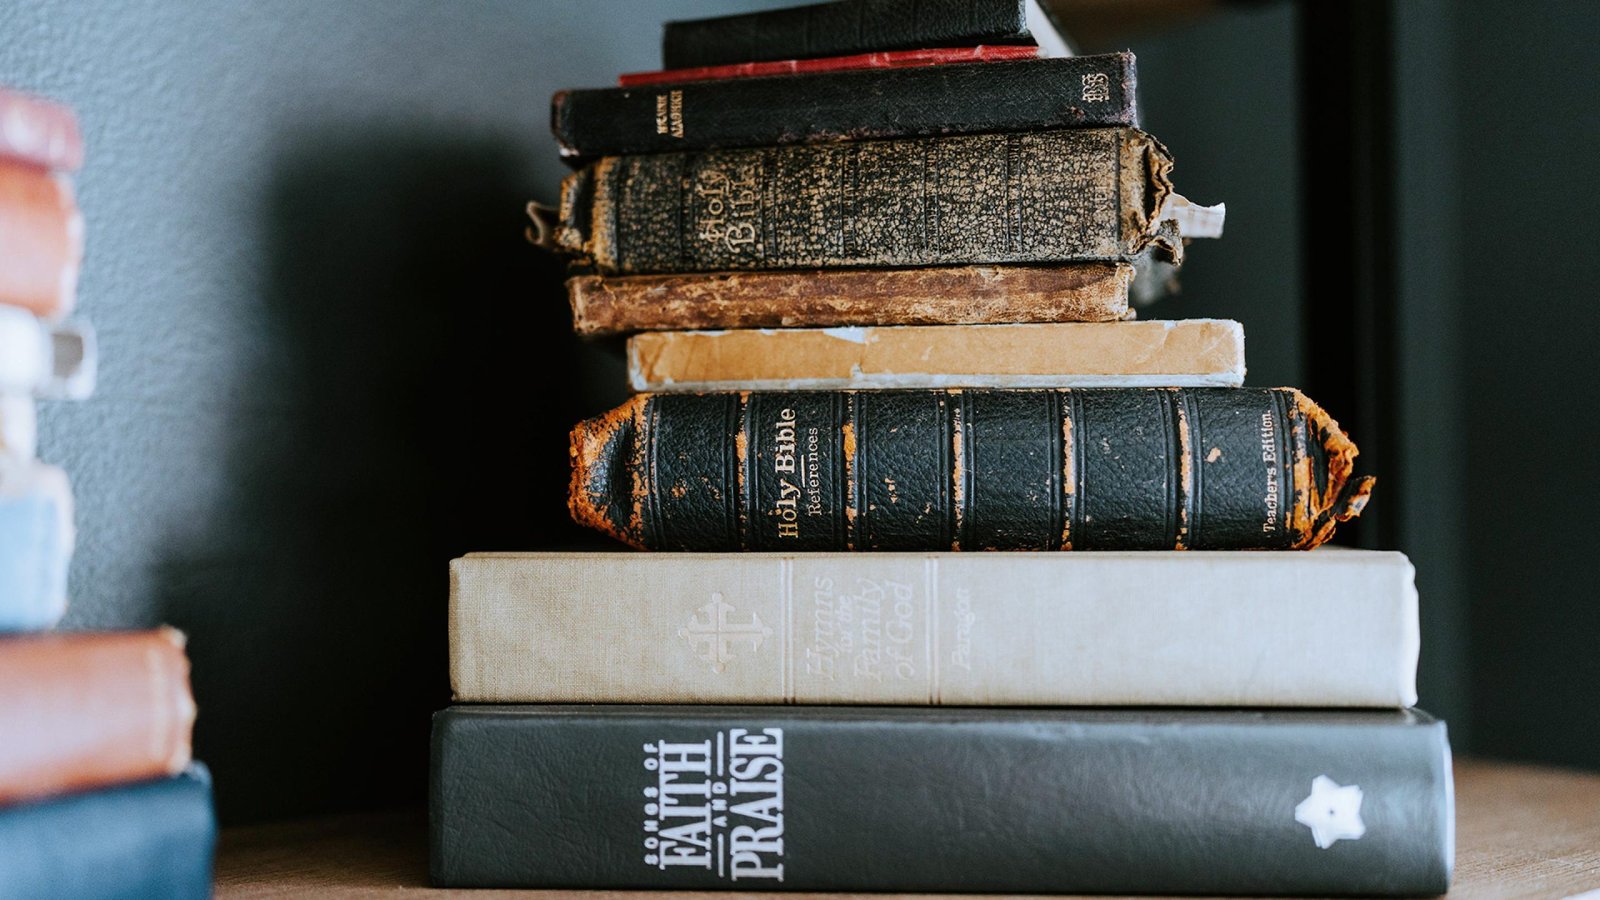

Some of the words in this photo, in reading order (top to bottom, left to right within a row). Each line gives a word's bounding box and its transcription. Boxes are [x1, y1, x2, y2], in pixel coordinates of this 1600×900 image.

[696, 170, 732, 242] Holy
[725, 167, 755, 253] Bible
[1092, 151, 1108, 213] NELON
[775, 408, 796, 473] Bible
[1261, 409, 1276, 464] Edition.
[807, 427, 822, 516] References
[777, 479, 801, 538] Holy
[806, 576, 840, 681] Hymns
[834, 595, 853, 623] the
[853, 578, 885, 682] Family
[884, 579, 914, 644] God
[951, 588, 976, 671] Paragon
[836, 630, 853, 654] for
[886, 646, 915, 680] of
[643, 743, 659, 771] OF
[643, 786, 659, 865] SONGS
[658, 739, 712, 870] FAITH
[711, 781, 728, 828] AND
[729, 727, 784, 882] PRAISE
